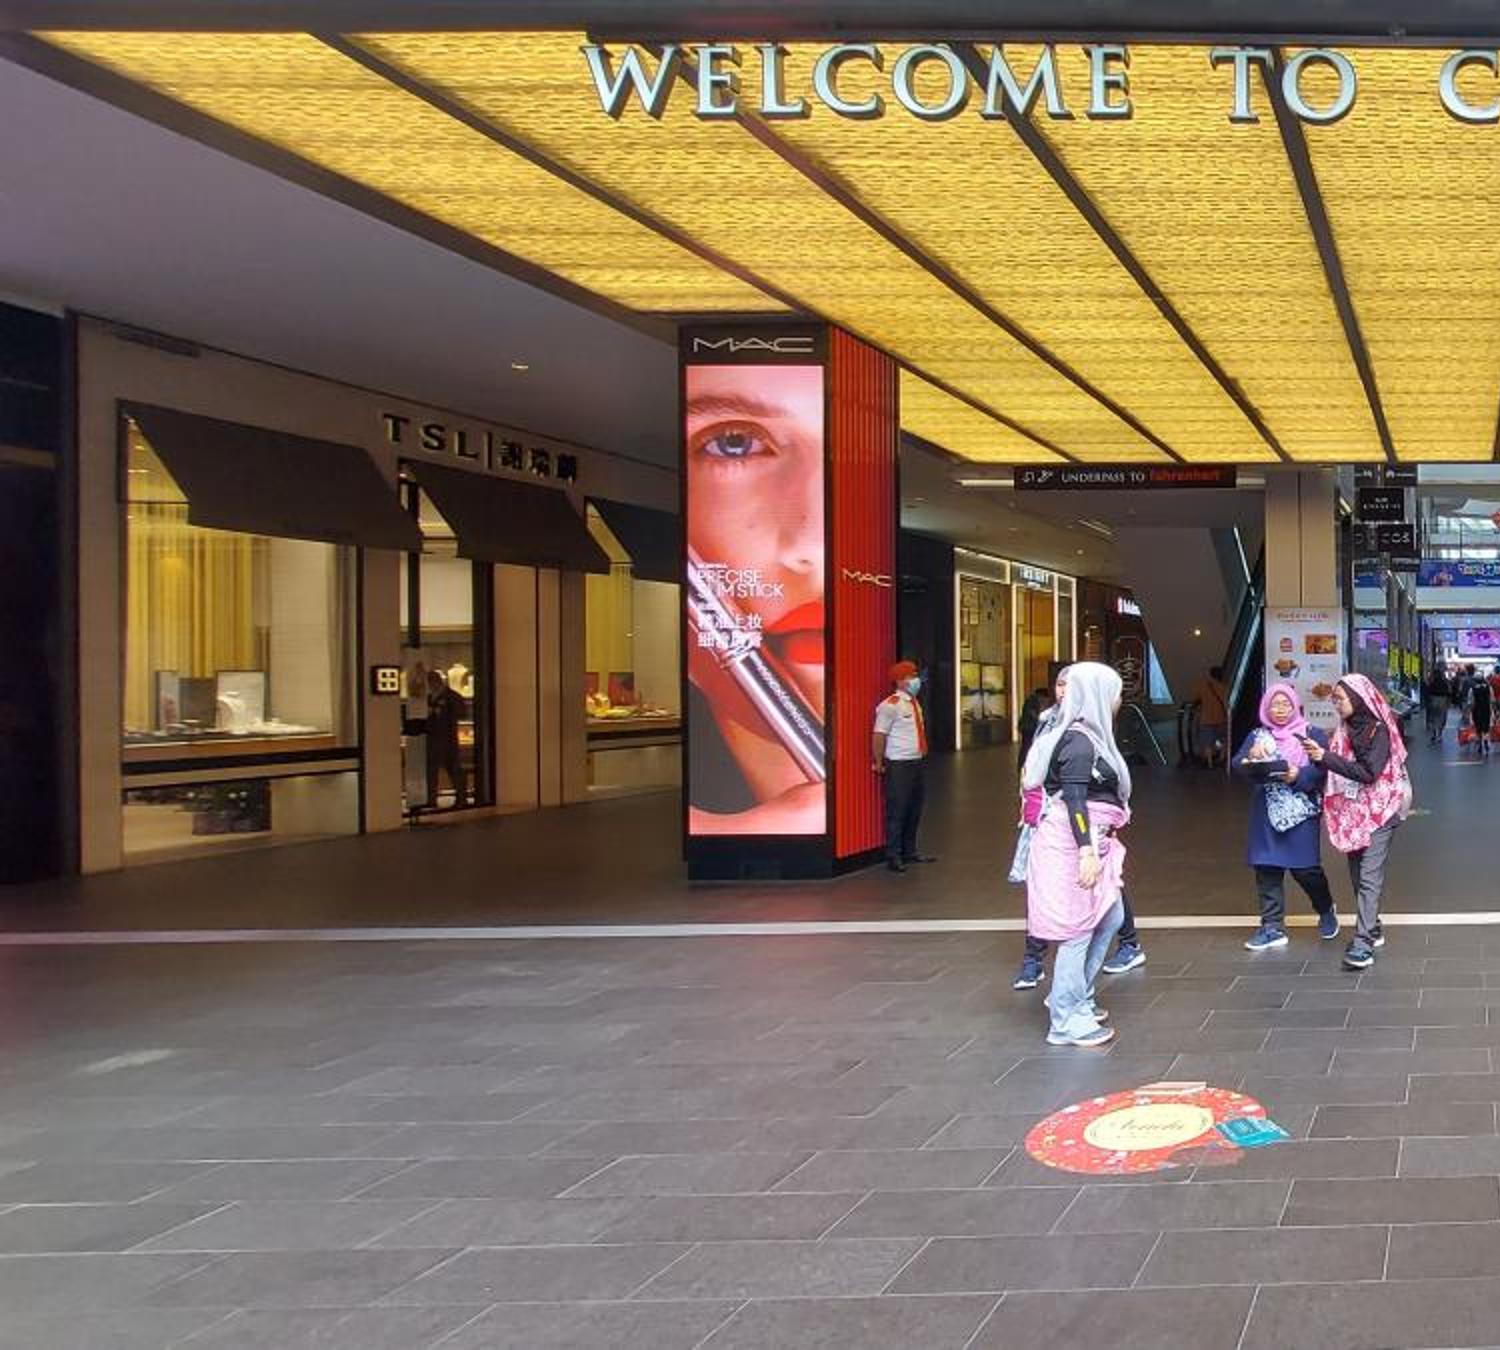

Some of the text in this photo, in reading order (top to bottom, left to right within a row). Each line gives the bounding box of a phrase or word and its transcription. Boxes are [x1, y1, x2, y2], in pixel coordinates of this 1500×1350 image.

[579, 43, 1133, 121] WELCOME
[1210, 46, 1358, 123] TO
[383, 413, 480, 461] TSL
[1061, 471, 1125, 484] UNDERPASS
[1130, 473, 1145, 483] TO
[699, 569, 764, 584] PRECISE
